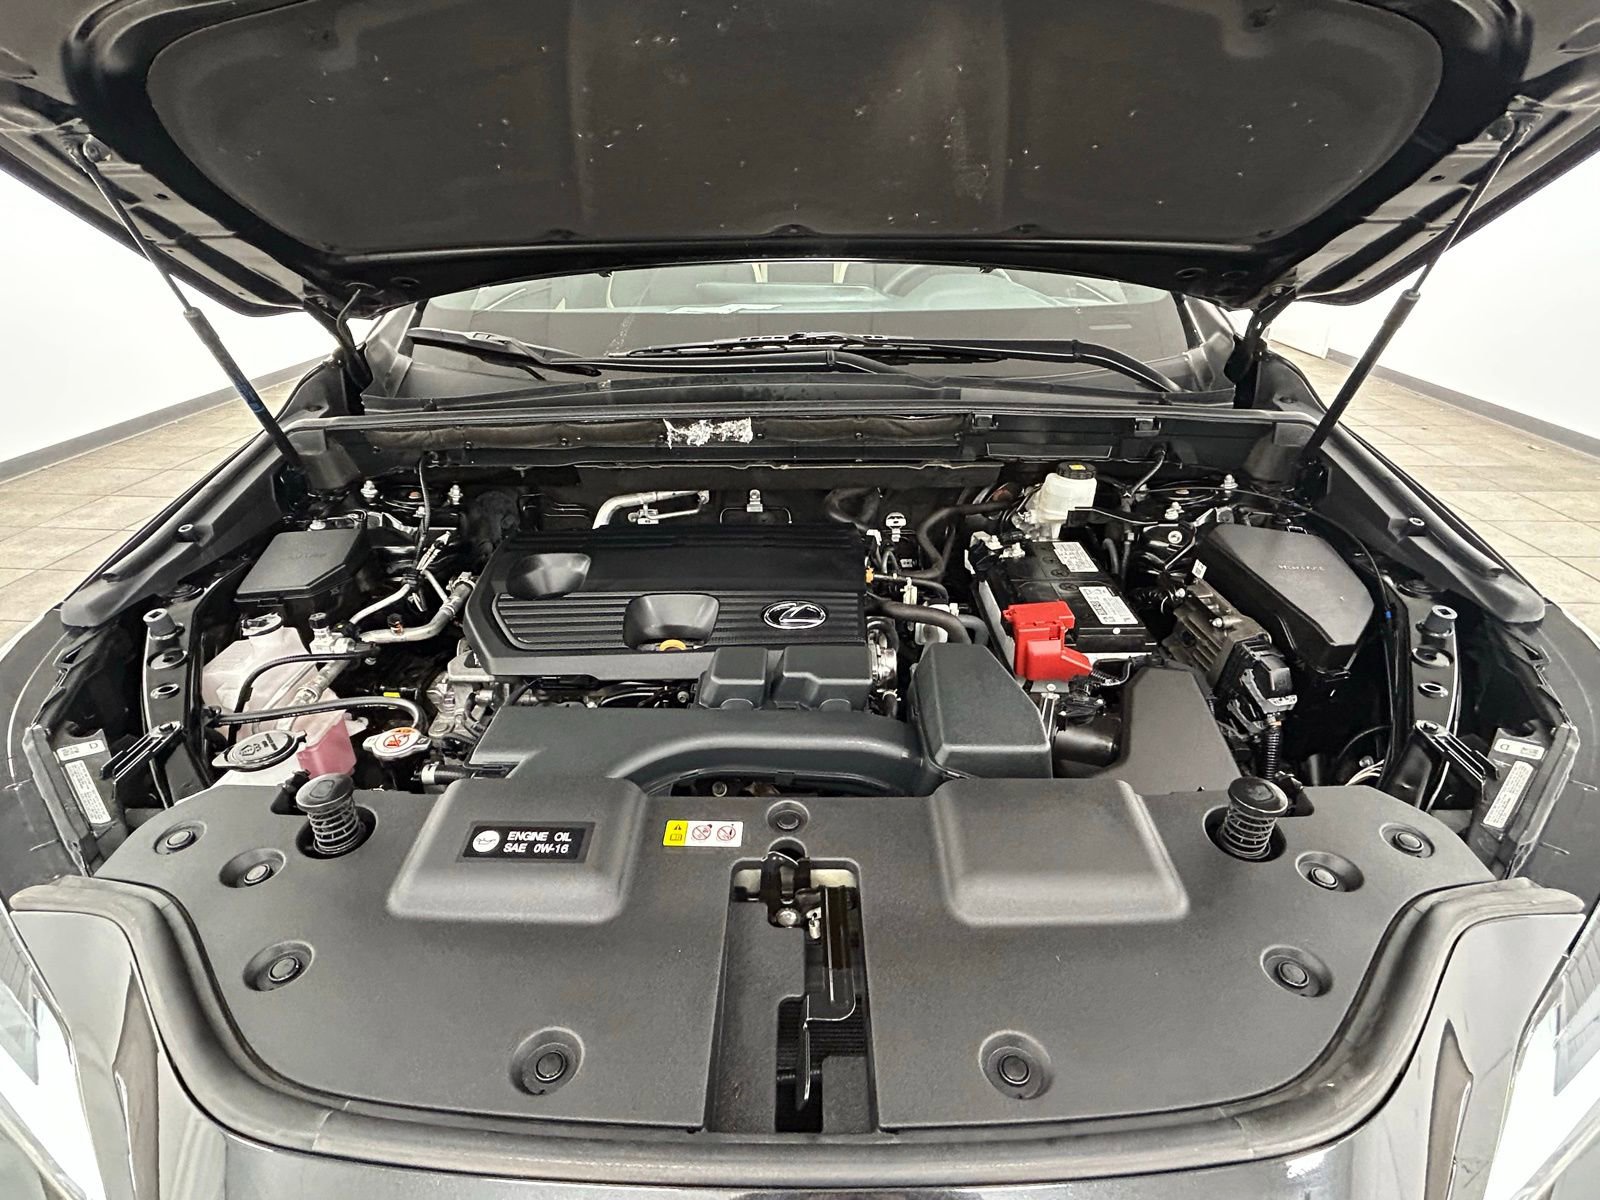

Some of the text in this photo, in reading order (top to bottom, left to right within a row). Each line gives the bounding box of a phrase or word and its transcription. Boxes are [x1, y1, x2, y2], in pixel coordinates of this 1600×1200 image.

[507, 831, 572, 842] ENGINE OIL
[503, 843, 570, 854] SAE 0W-16
